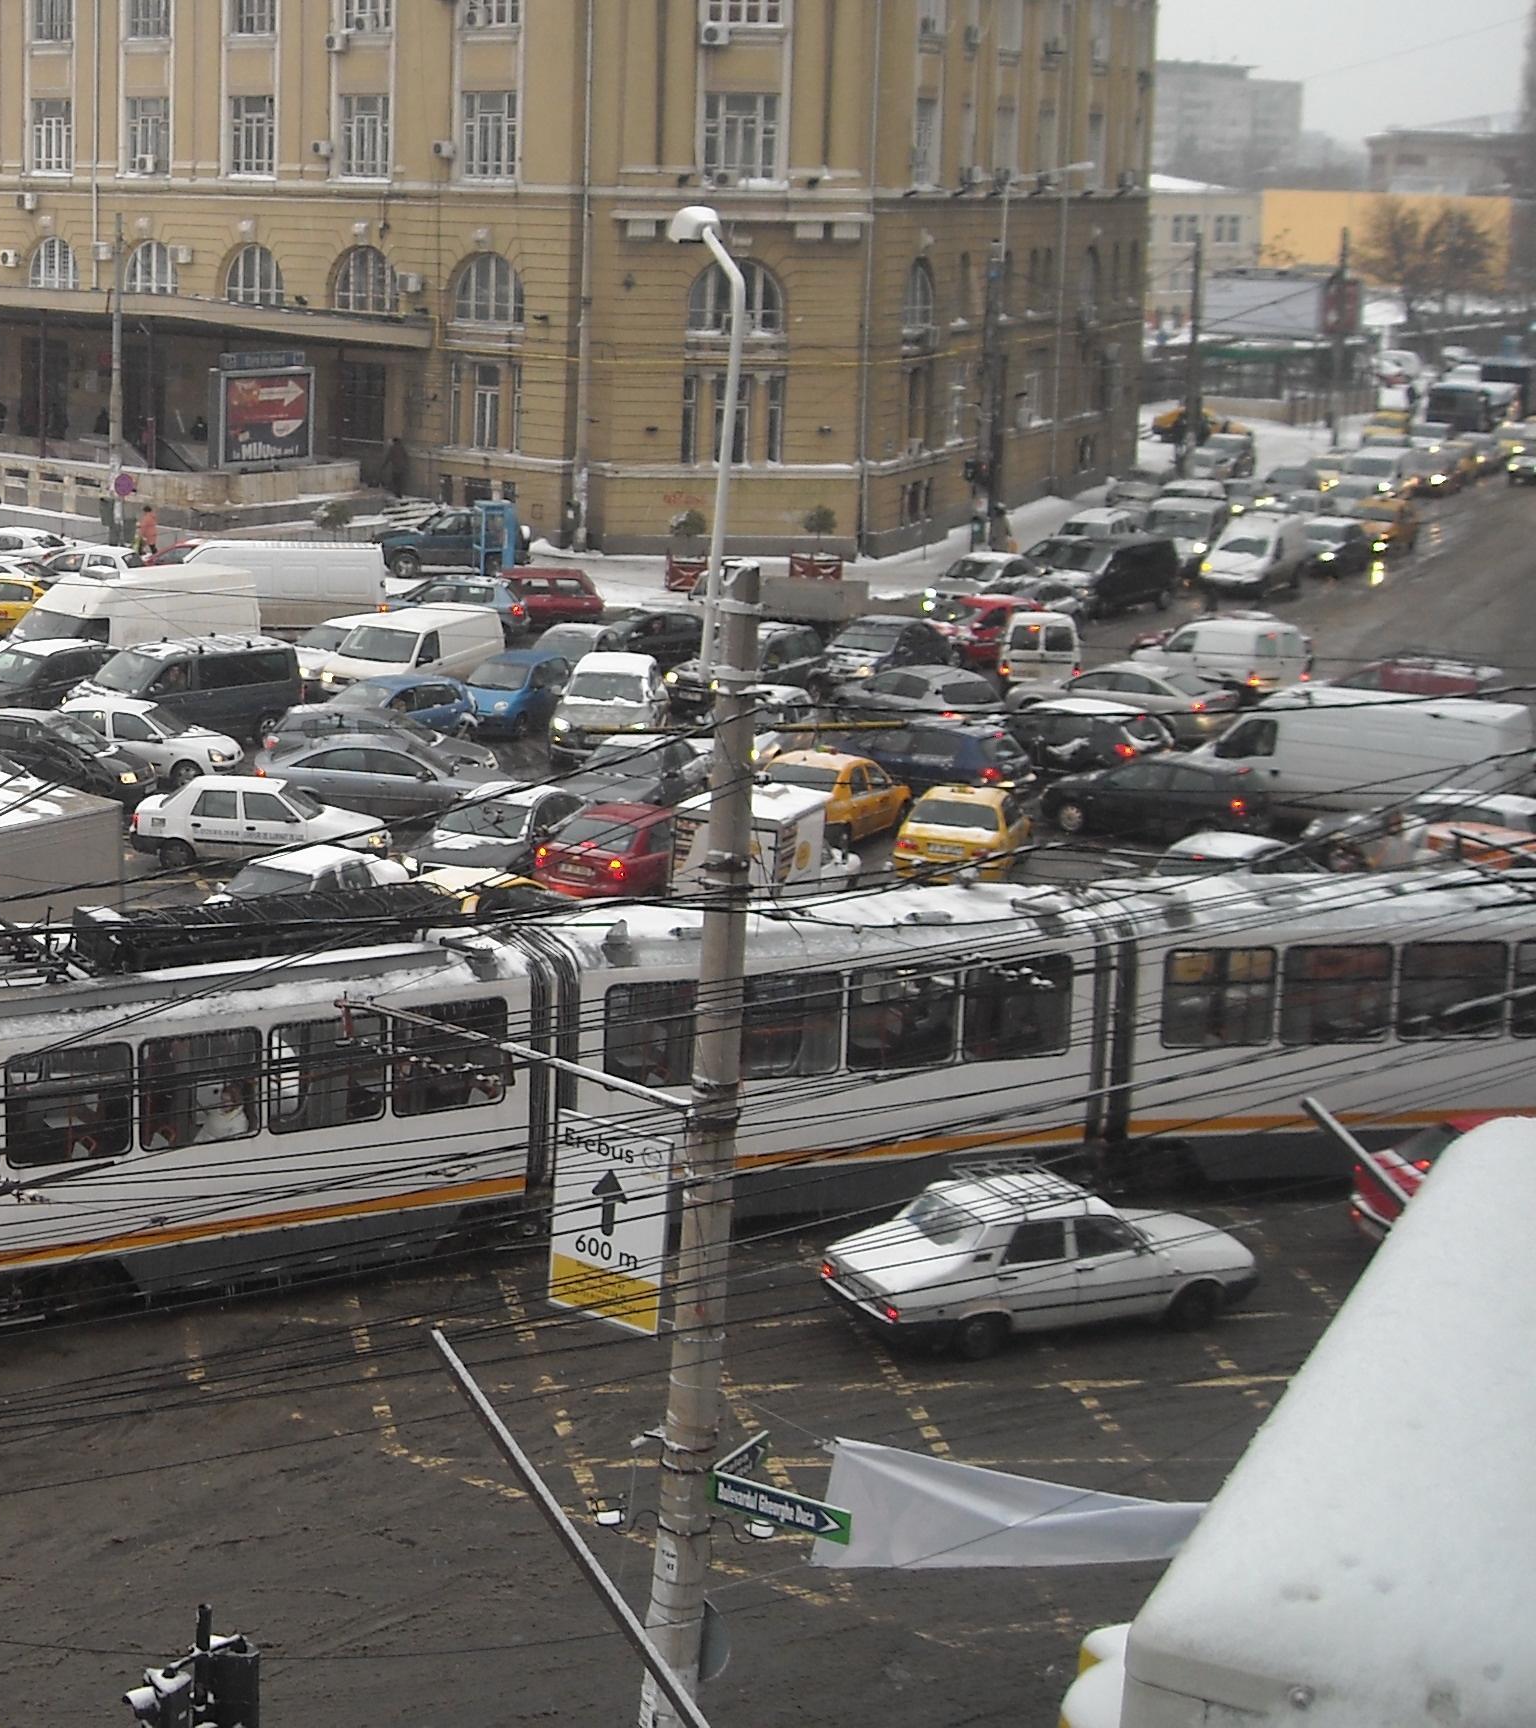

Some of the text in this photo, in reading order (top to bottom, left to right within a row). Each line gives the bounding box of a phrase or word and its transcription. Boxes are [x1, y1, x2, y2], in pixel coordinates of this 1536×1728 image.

[564, 1126, 635, 1165] Erebus
[575, 1234, 639, 1269] 600 m
[759, 1493, 795, 1523] Gheorghe
[795, 1505, 816, 1528] Duca
